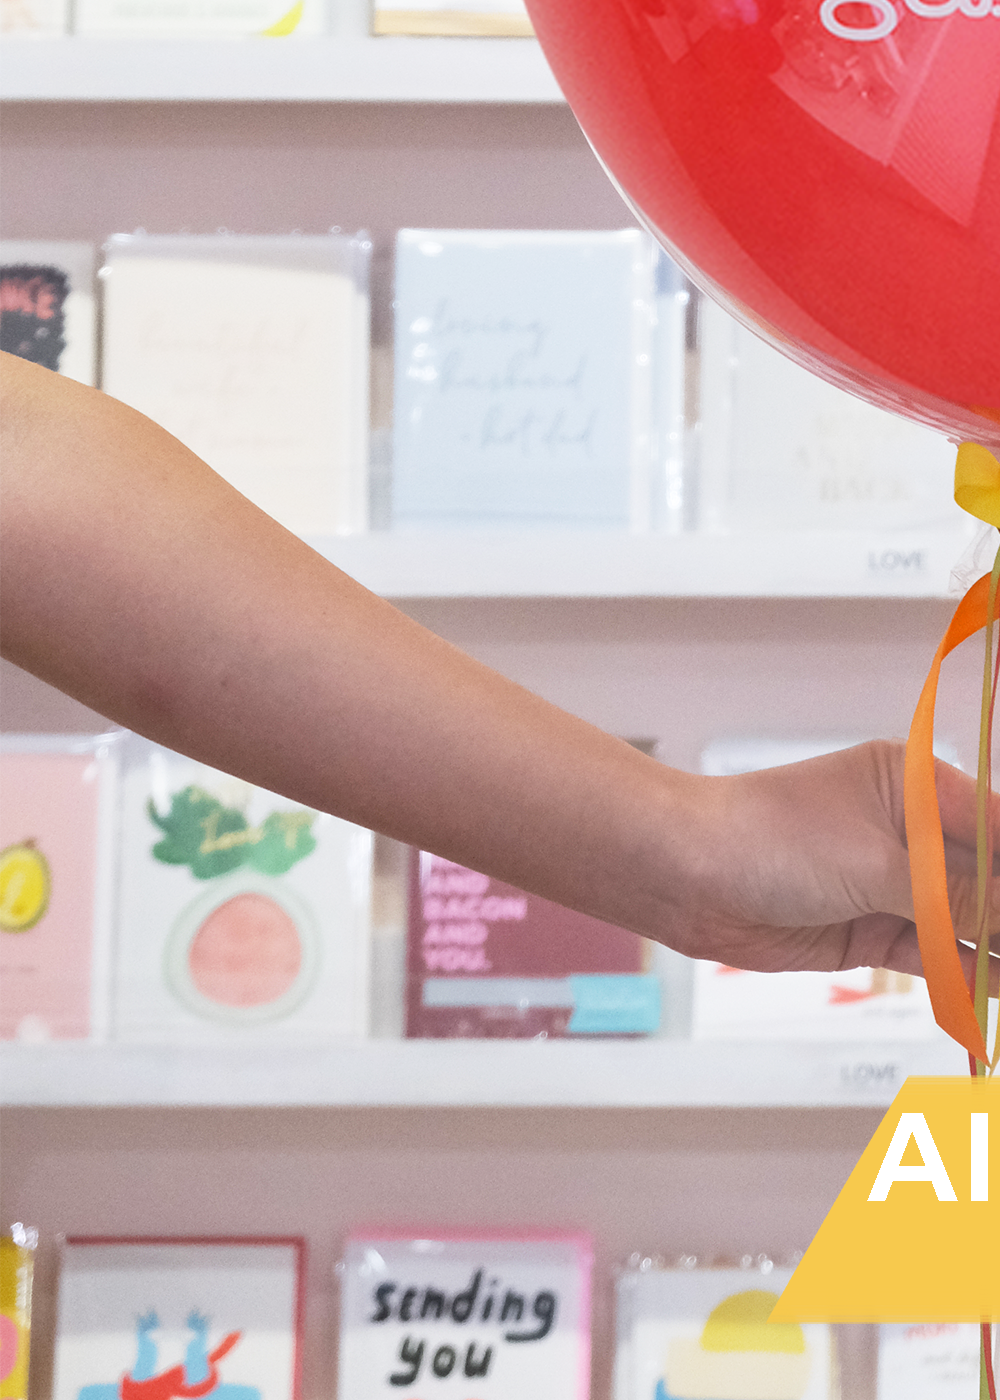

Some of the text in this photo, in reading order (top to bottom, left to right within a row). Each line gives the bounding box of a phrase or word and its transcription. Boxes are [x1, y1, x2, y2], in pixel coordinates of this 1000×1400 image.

[867, 550, 927, 570] LOVE
[423, 896, 528, 920] BACON
[424, 921, 489, 944] AND
[840, 1063, 899, 1085] LOVE
[371, 1267, 556, 1343] sending
[388, 1335, 493, 1387] you
